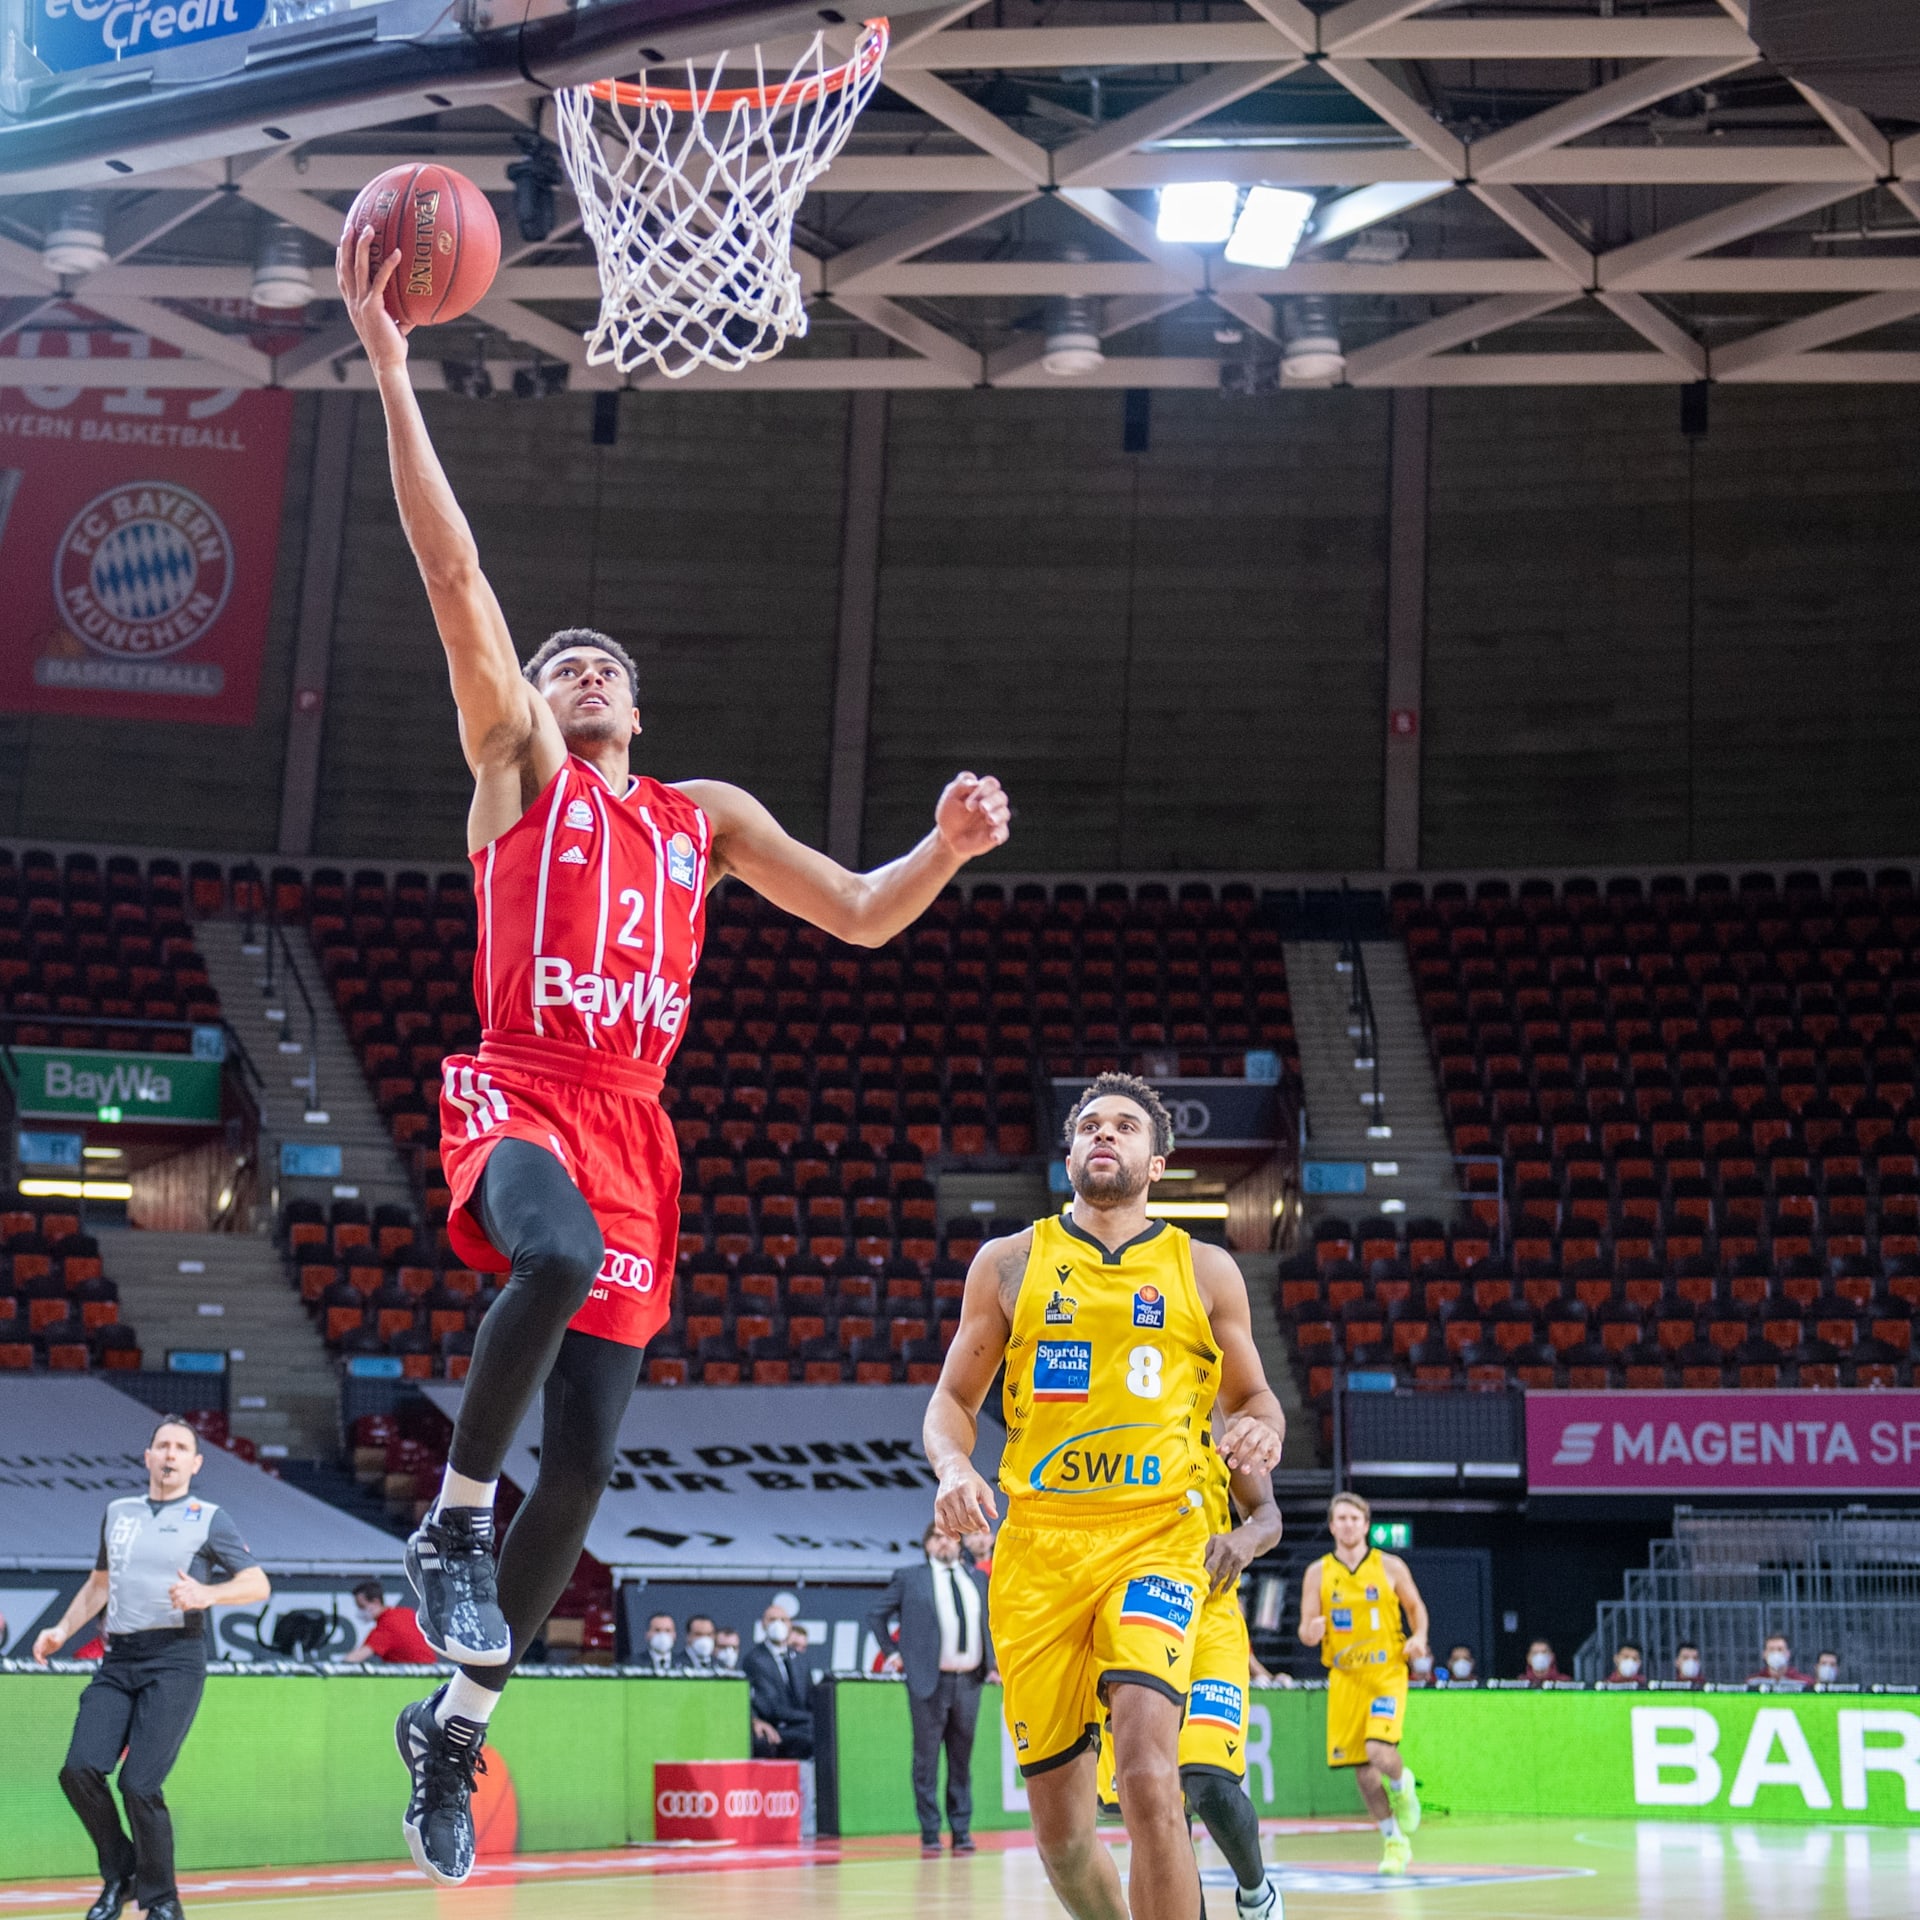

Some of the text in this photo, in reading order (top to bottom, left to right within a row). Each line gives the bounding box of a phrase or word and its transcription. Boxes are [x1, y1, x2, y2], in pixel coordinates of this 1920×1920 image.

[406, 187, 440, 296] SPALDING
[0, 412, 245, 450] YERN BASKETBALL
[70, 490, 223, 561] FC BAYERN
[617, 888, 645, 948] 2
[533, 956, 685, 1036] BayWa
[44, 1062, 172, 1105] BayWa
[1136, 1313, 1161, 1326] BBL
[1037, 1345, 1089, 1362] Sparda
[1047, 1358, 1089, 1371] Bank
[1125, 1344, 1164, 1399] 8
[1067, 1374, 1088, 1386] BW
[1612, 1421, 1860, 1465] MAGENTA
[1060, 1450, 1162, 1487] SWLB
[1146, 1585, 1193, 1613] Bank
[1370, 1607, 1381, 1631] 1
[1204, 1690, 1241, 1711] Bank
[1631, 1706, 1920, 1811] BAR
